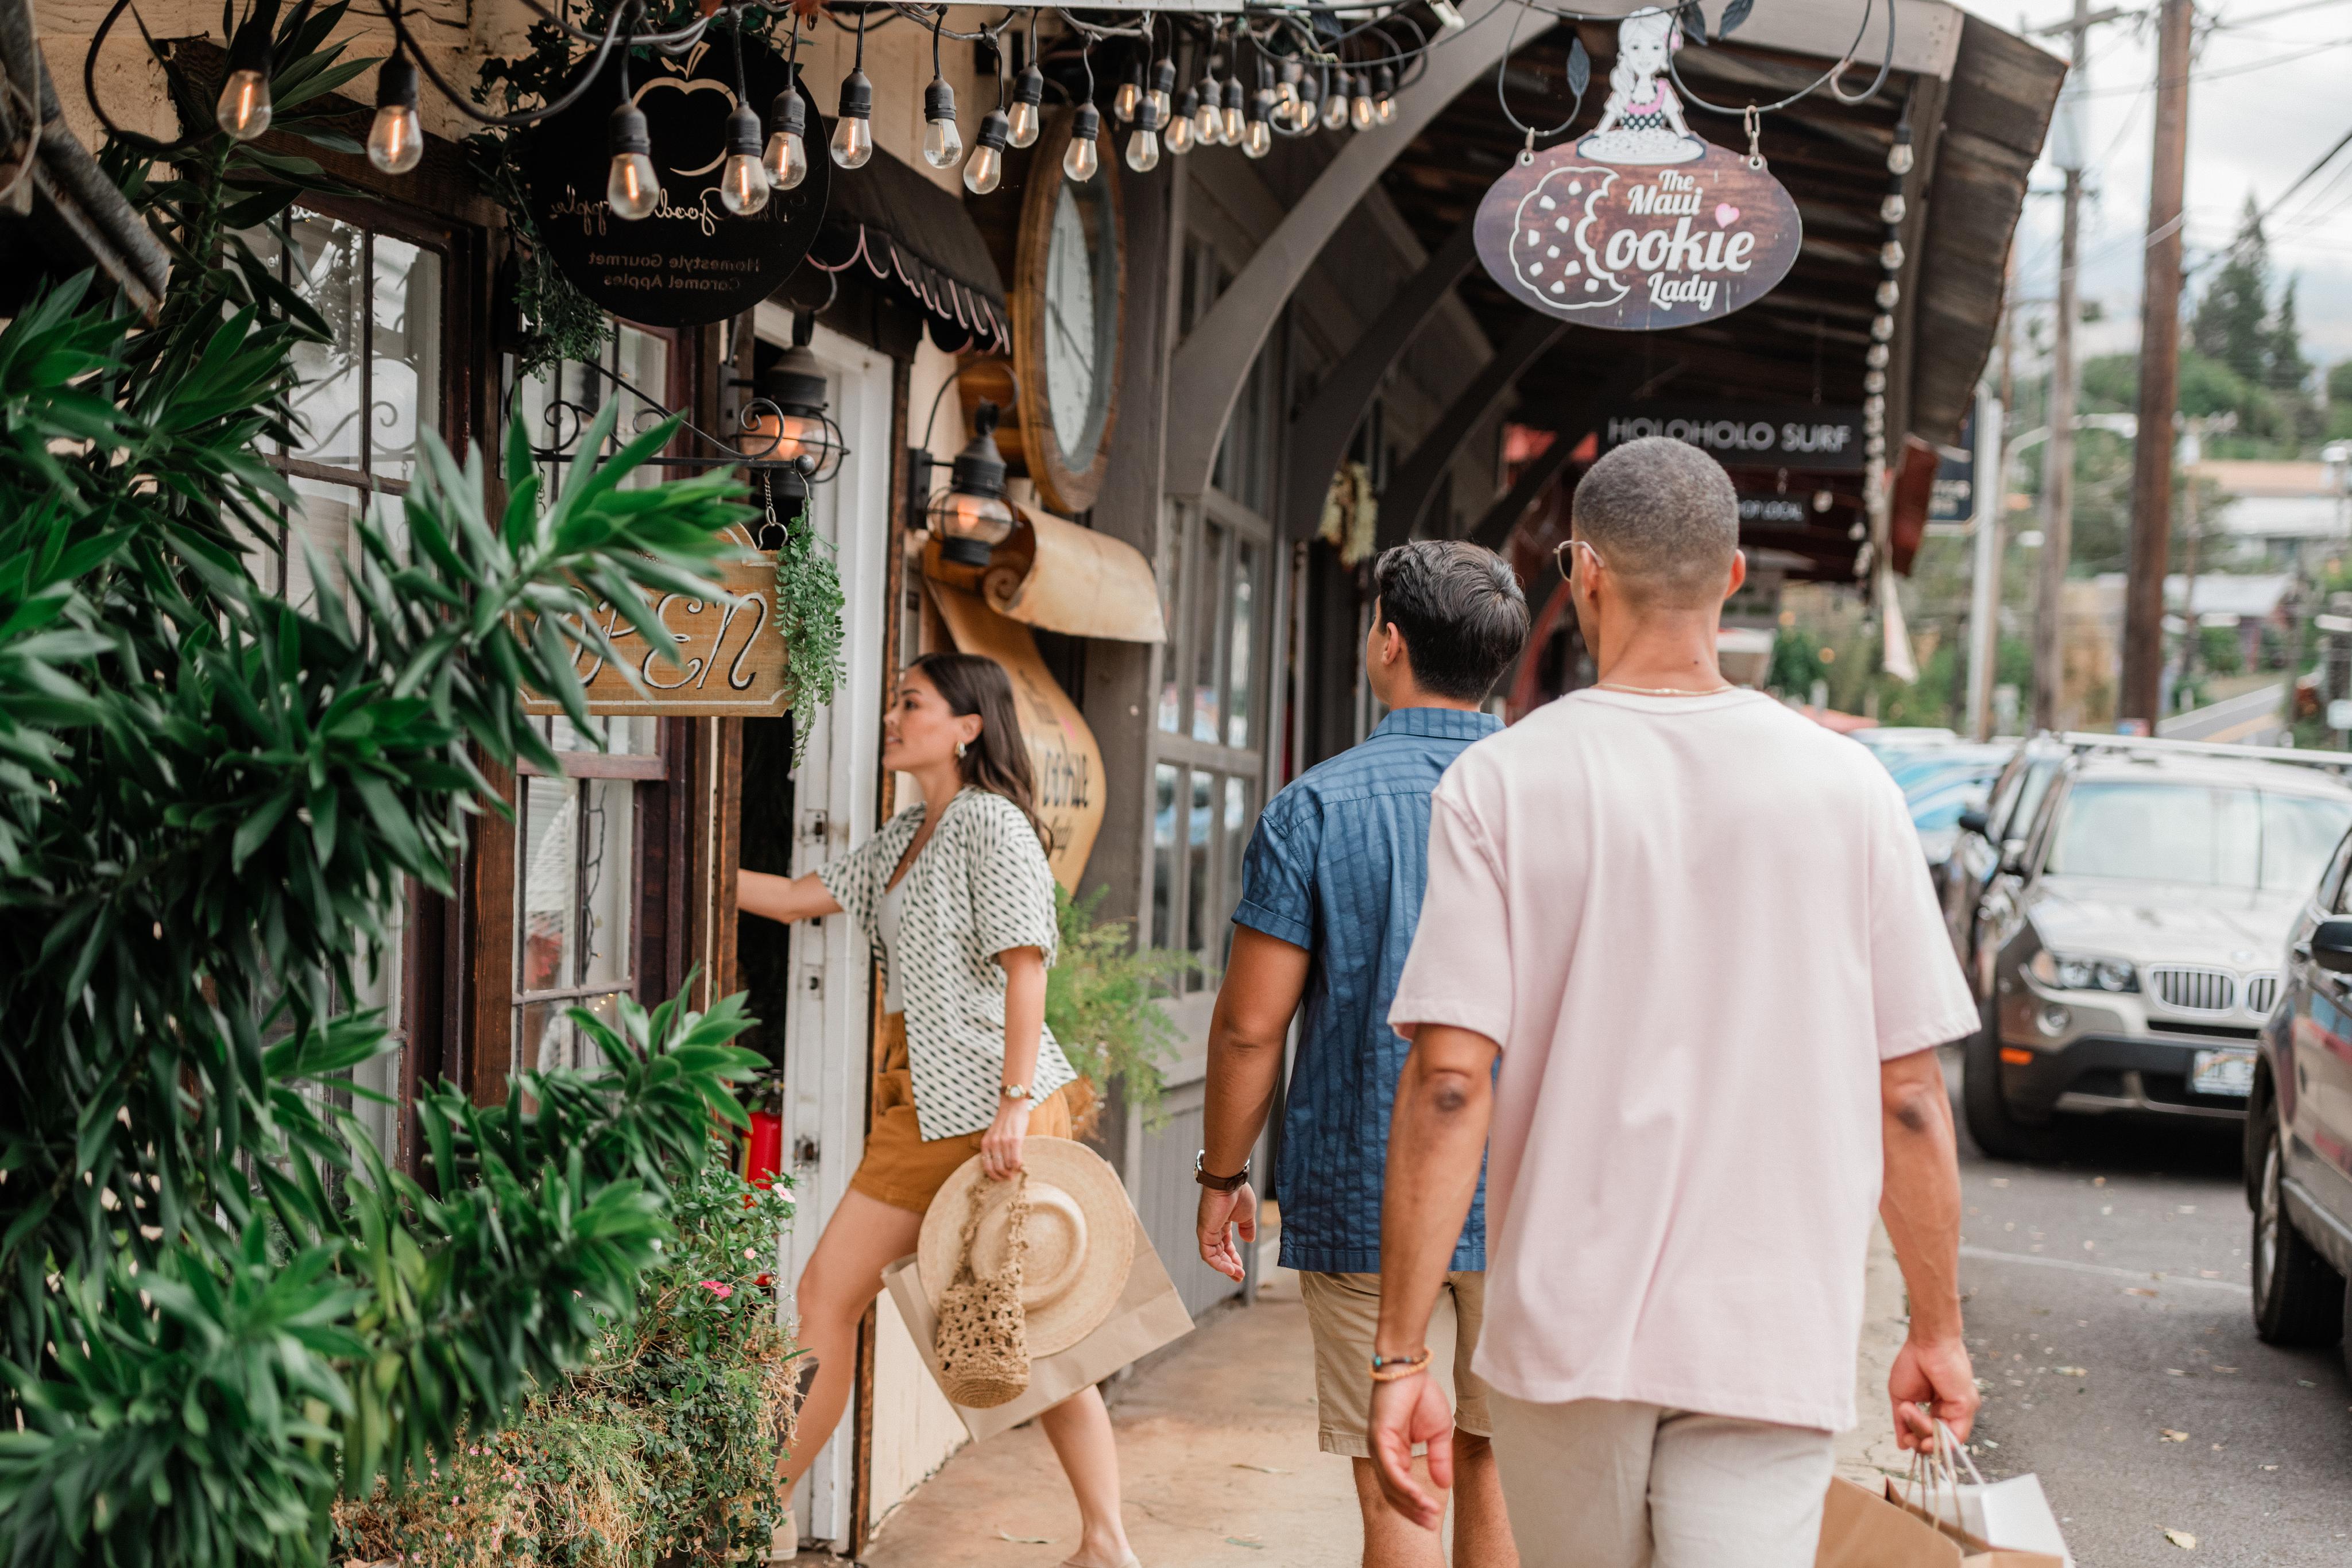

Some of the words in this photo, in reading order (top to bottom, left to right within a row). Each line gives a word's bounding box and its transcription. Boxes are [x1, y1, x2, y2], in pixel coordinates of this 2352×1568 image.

[1659, 169, 1695, 192] The
[1627, 185, 1704, 215] Maui
[1647, 271, 1717, 312] Lady
[1781, 422, 1851, 453] SURF
